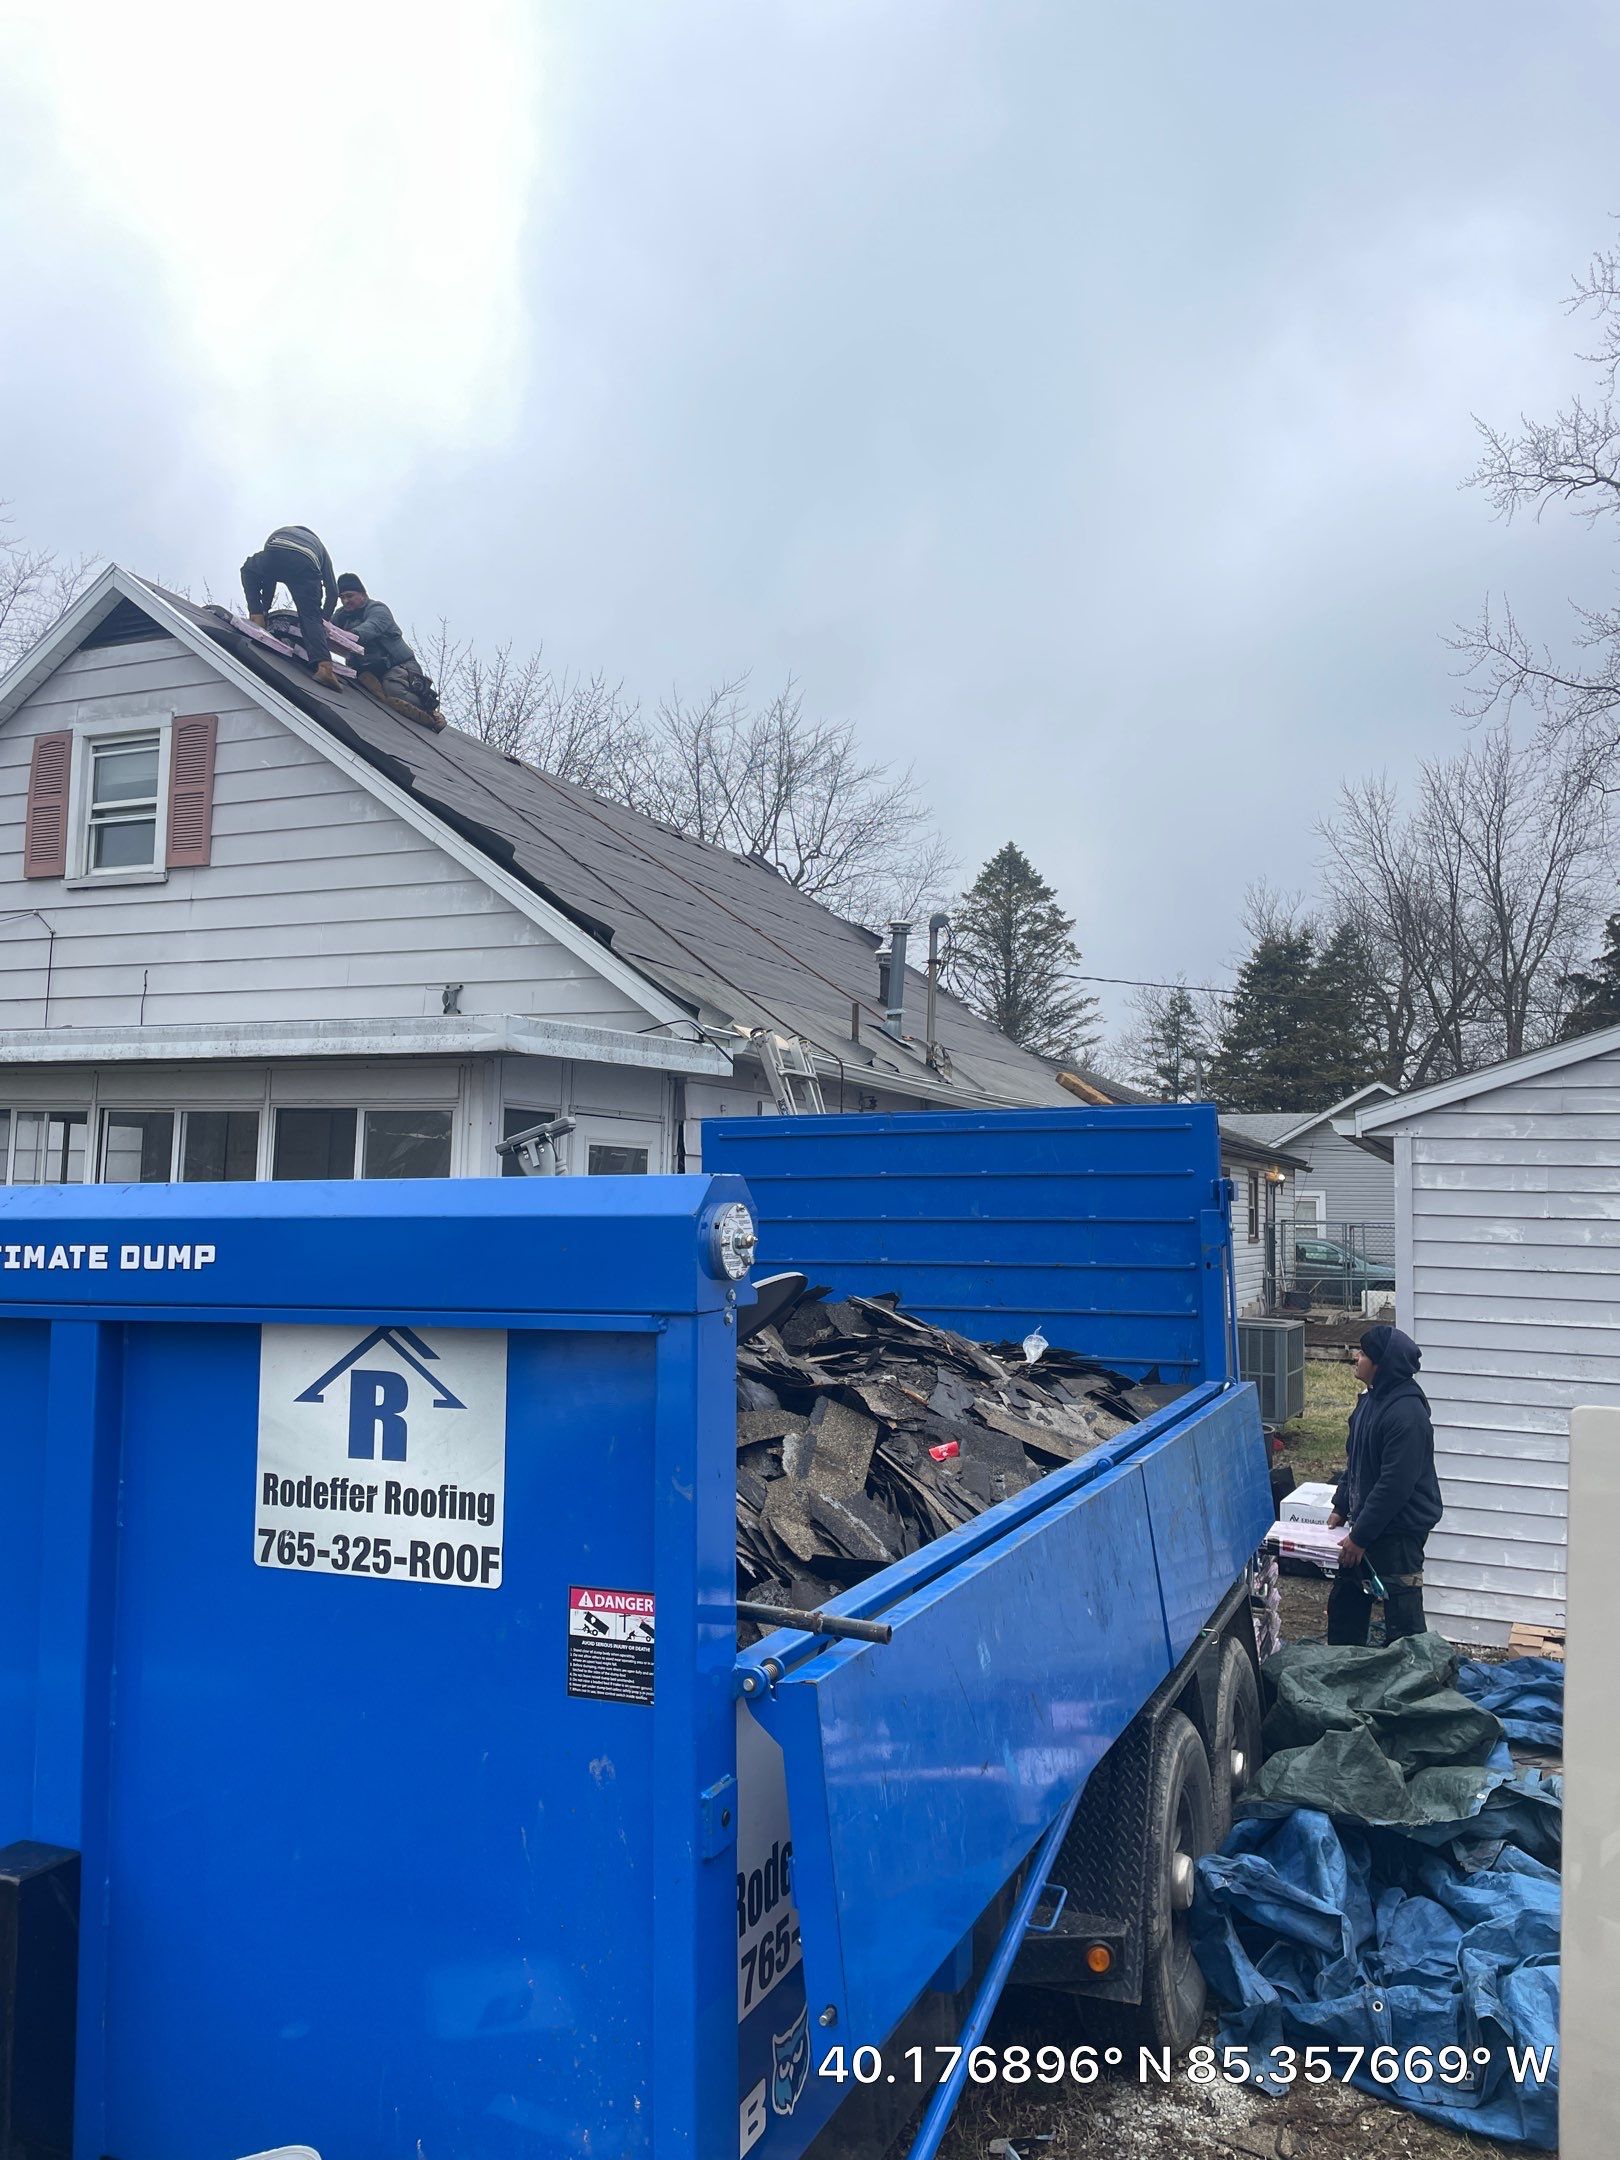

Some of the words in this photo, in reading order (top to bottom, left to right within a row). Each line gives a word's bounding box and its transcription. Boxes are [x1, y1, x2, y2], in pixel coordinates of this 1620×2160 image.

[0, 1245, 109, 1270] IMATE
[120, 1245, 216, 1270] DUMP
[347, 1369, 409, 1462] R
[262, 1472, 378, 1513] Rodeffer
[384, 1480, 495, 1526] Roofing
[258, 1528, 500, 1584] 765-325-ROOF
[594, 1594, 654, 1613] DANGER
